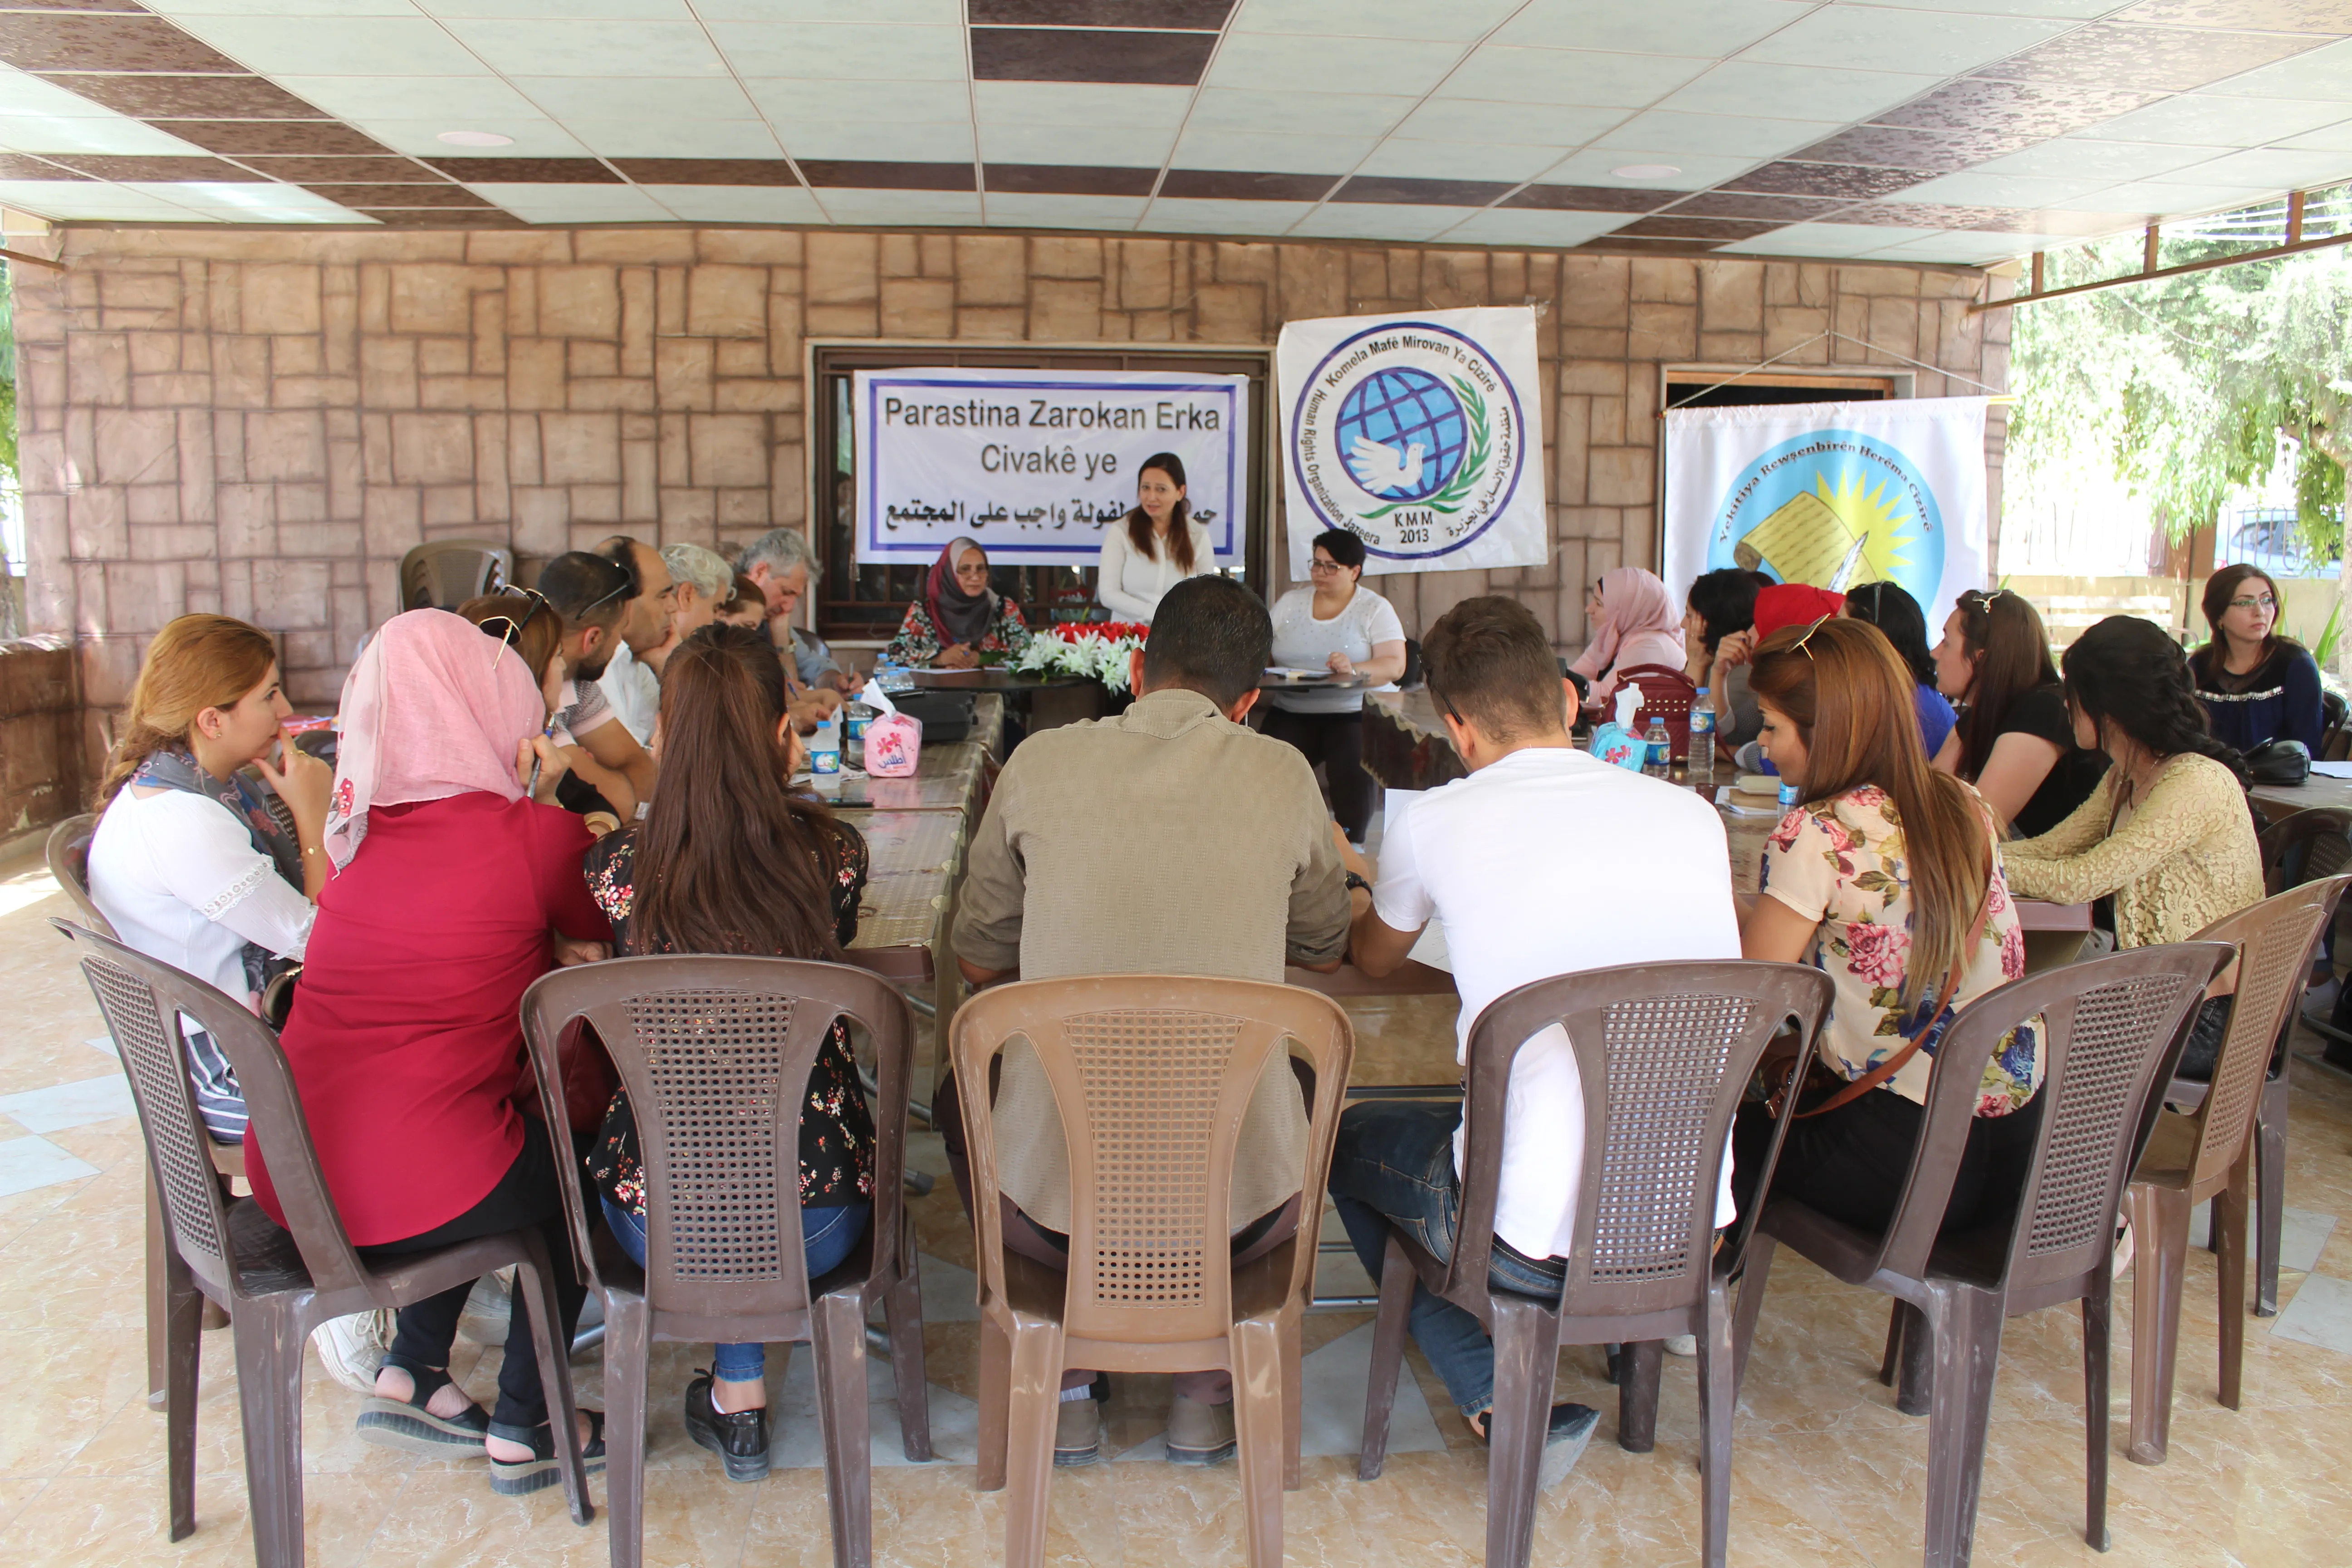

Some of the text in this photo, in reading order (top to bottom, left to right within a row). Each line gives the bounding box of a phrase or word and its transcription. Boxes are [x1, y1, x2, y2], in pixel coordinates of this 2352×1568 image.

[1325, 350, 1368, 387] Komela
[1368, 336, 1399, 356] Mafê
[1402, 335, 1450, 356] Mirovan
[1454, 346, 1466, 364] Ya
[886, 398, 1220, 430] Parastina Zarokan Erka
[981, 443, 1117, 481] Civakê ye
[1300, 389, 1380, 545] Human Rights Organization Jazeera
[1859, 445, 1908, 483] Herêma
[886, 499, 964, 531] المجتمع
[970, 500, 1009, 529] على
[1014, 501, 1066, 530] واجب
[1446, 506, 1480, 537] الجزيرة
[1478, 499, 1490, 514] في
[1401, 529, 1429, 544] 2013
